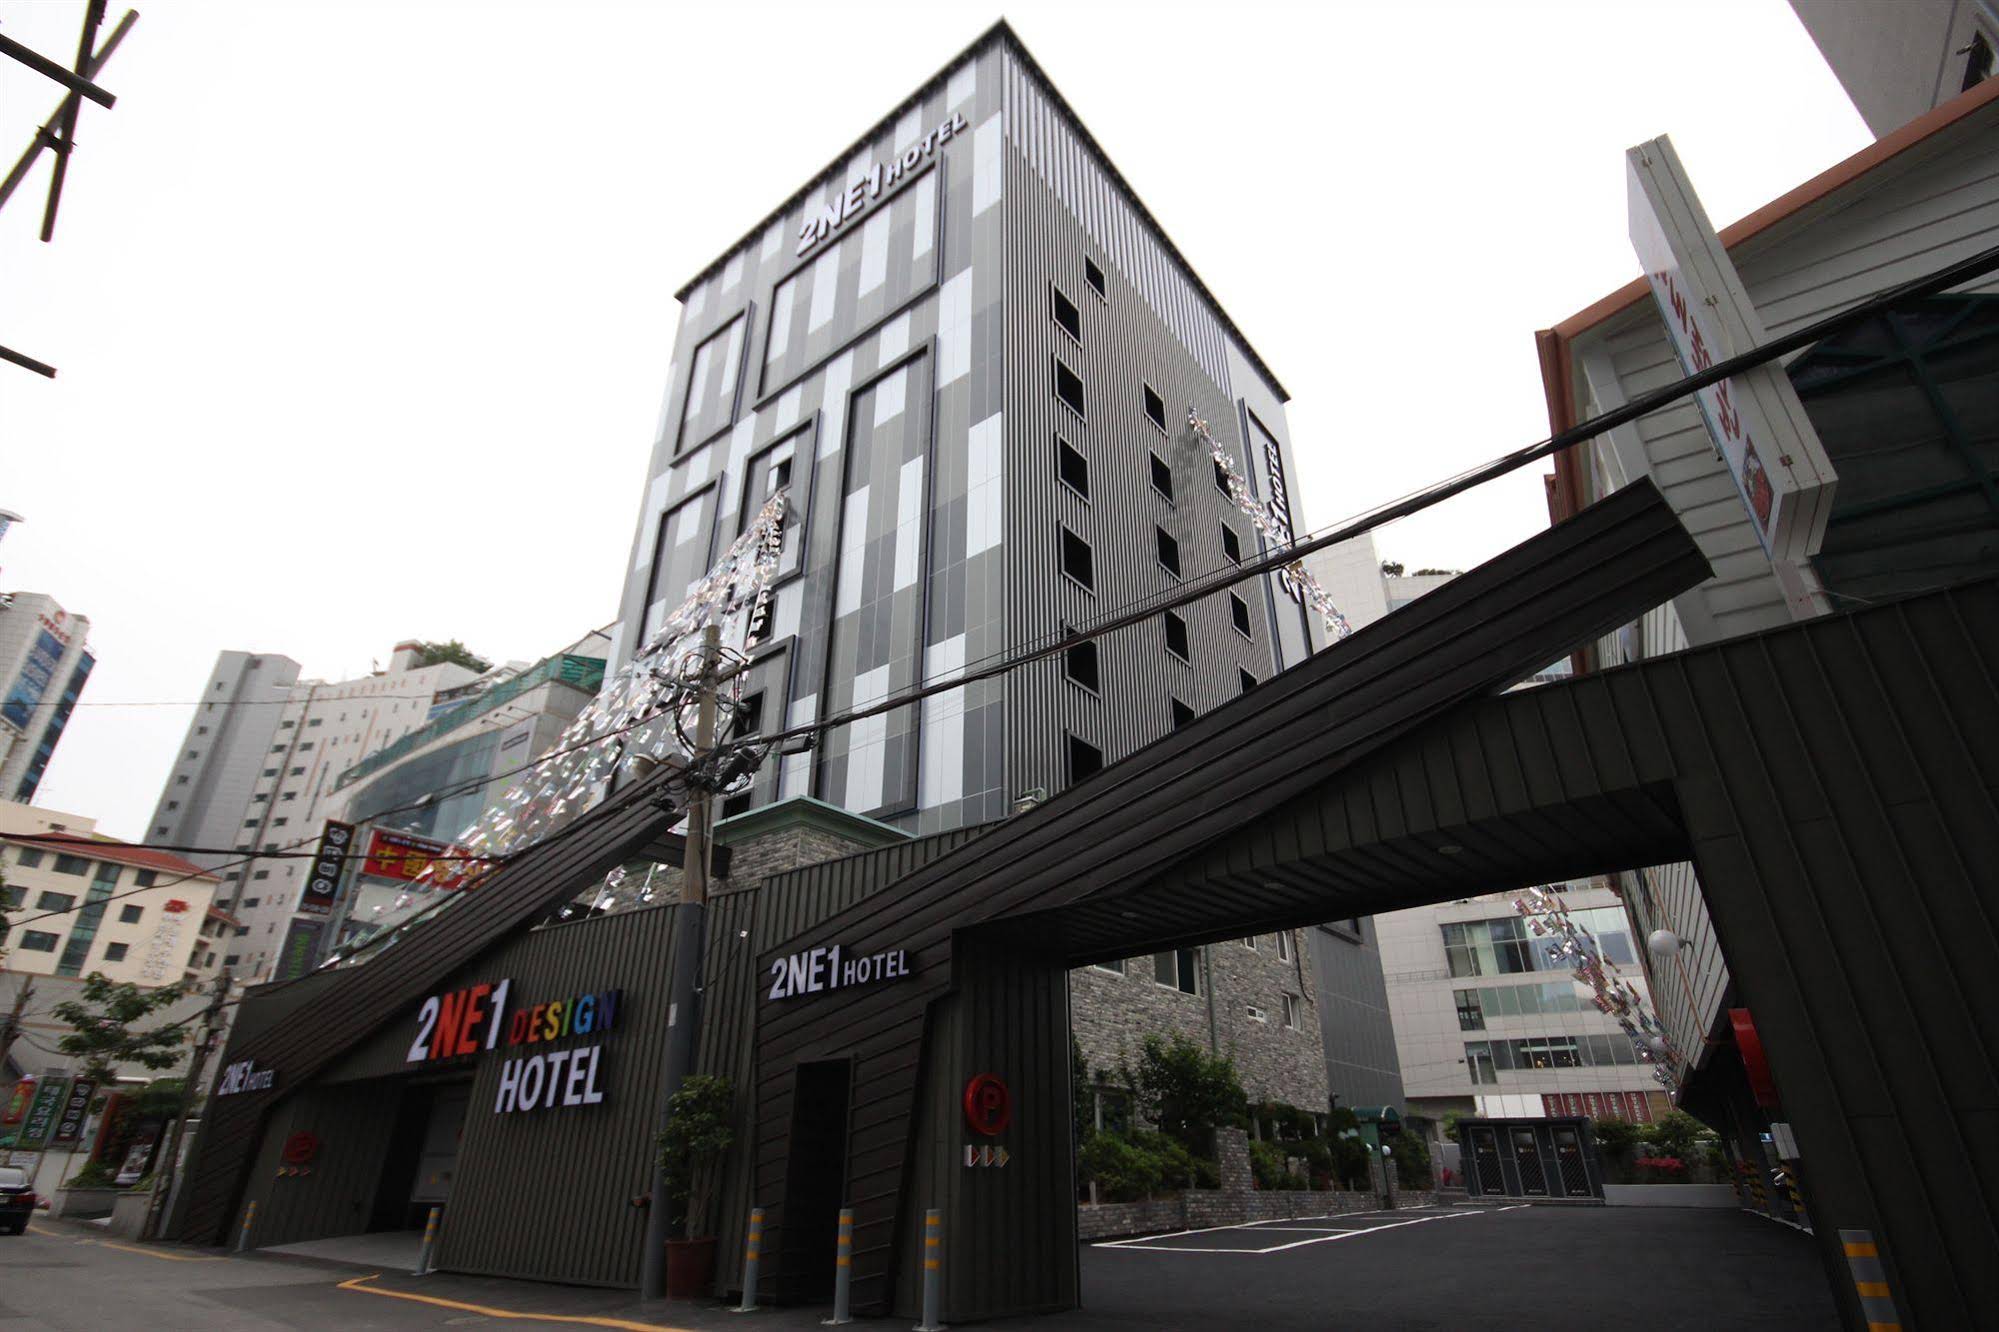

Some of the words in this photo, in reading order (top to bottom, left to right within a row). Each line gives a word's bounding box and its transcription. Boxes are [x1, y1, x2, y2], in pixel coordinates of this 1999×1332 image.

[796, 163, 883, 257] 2NE1
[886, 112, 967, 186] HOTEL
[1267, 443, 1287, 511] HOTEL
[768, 945, 840, 1000] 2NE1
[843, 950, 909, 986] HOTEL
[407, 978, 510, 1062] 2NE1
[509, 991, 619, 1046] DESIGN
[494, 1046, 603, 1114] HOTEL
